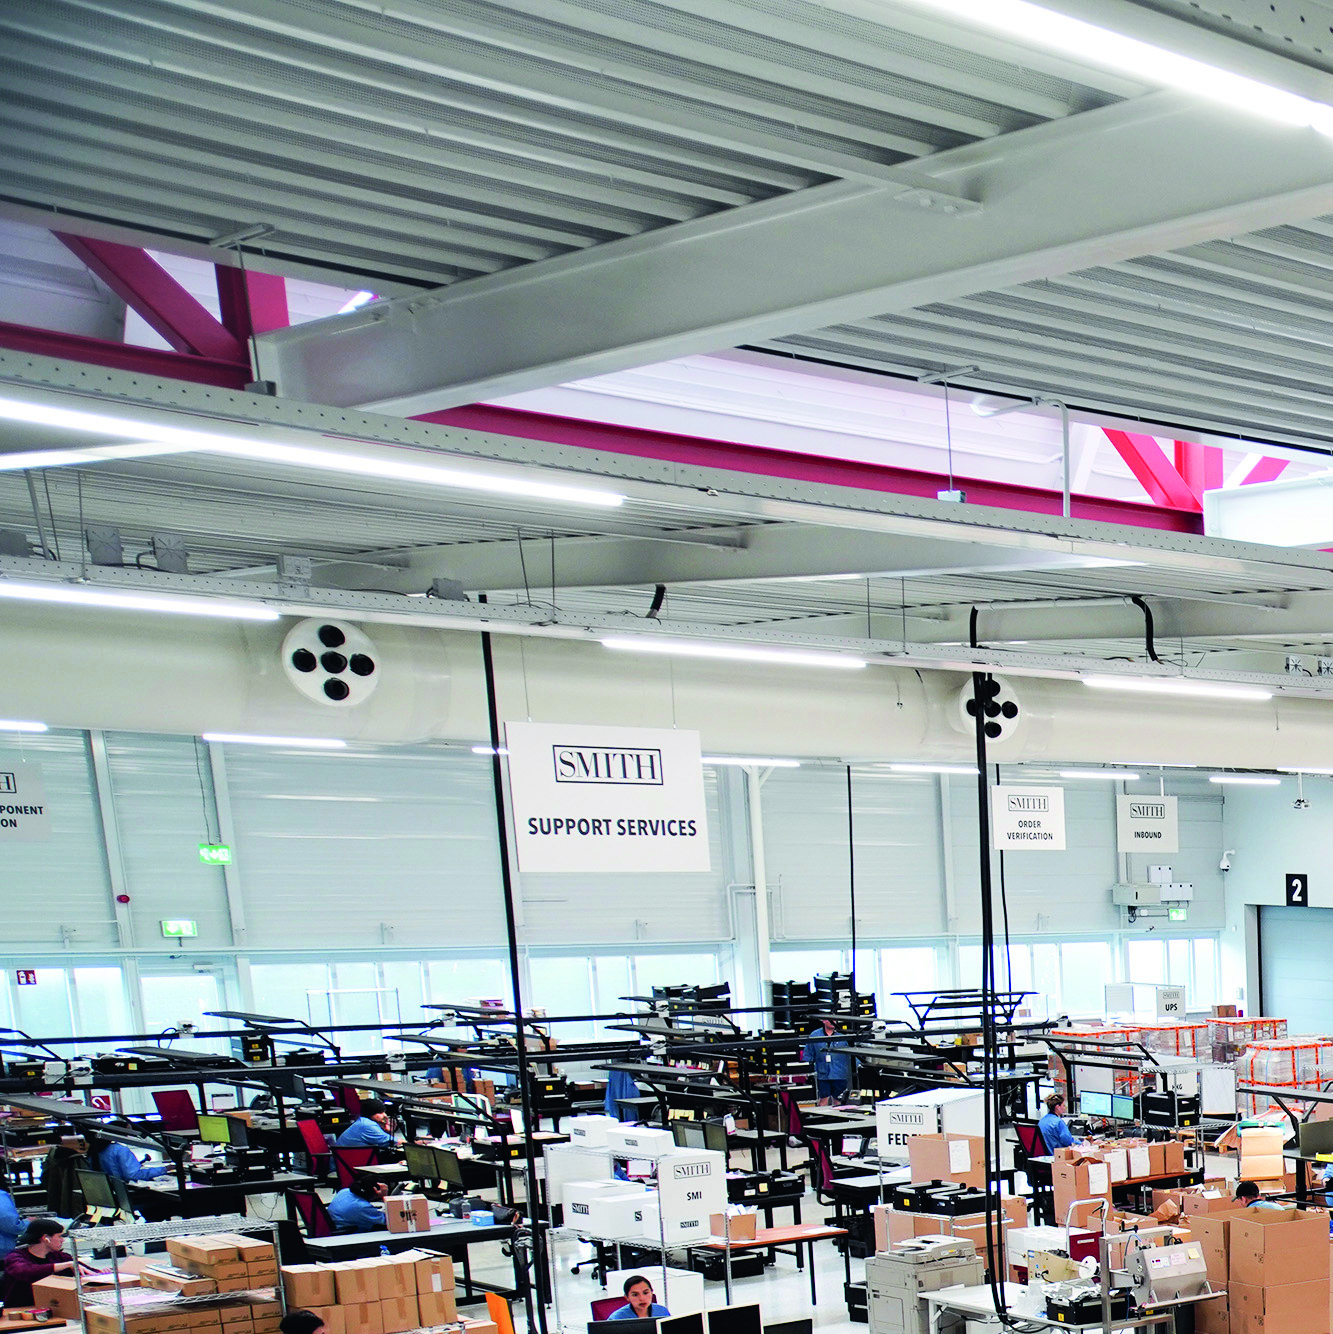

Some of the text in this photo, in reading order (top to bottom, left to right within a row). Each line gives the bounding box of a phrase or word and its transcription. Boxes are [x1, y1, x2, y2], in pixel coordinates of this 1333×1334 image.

[559, 749, 658, 781] SMITH
[1009, 797, 1047, 810] SMITH
[1131, 804, 1163, 818] SMITH
[528, 816, 698, 838] SUPPORT SERVICES
[1018, 820, 1041, 829] ORDER
[1007, 832, 1053, 841] VERIFICATION
[1134, 831, 1162, 839] INBOUND
[1292, 879, 1303, 903] 2
[1165, 1003, 1178, 1011] UPS
[891, 1113, 922, 1124] SMITH
[675, 1163, 710, 1177] SMITH
[686, 1191, 702, 1201] SMI
